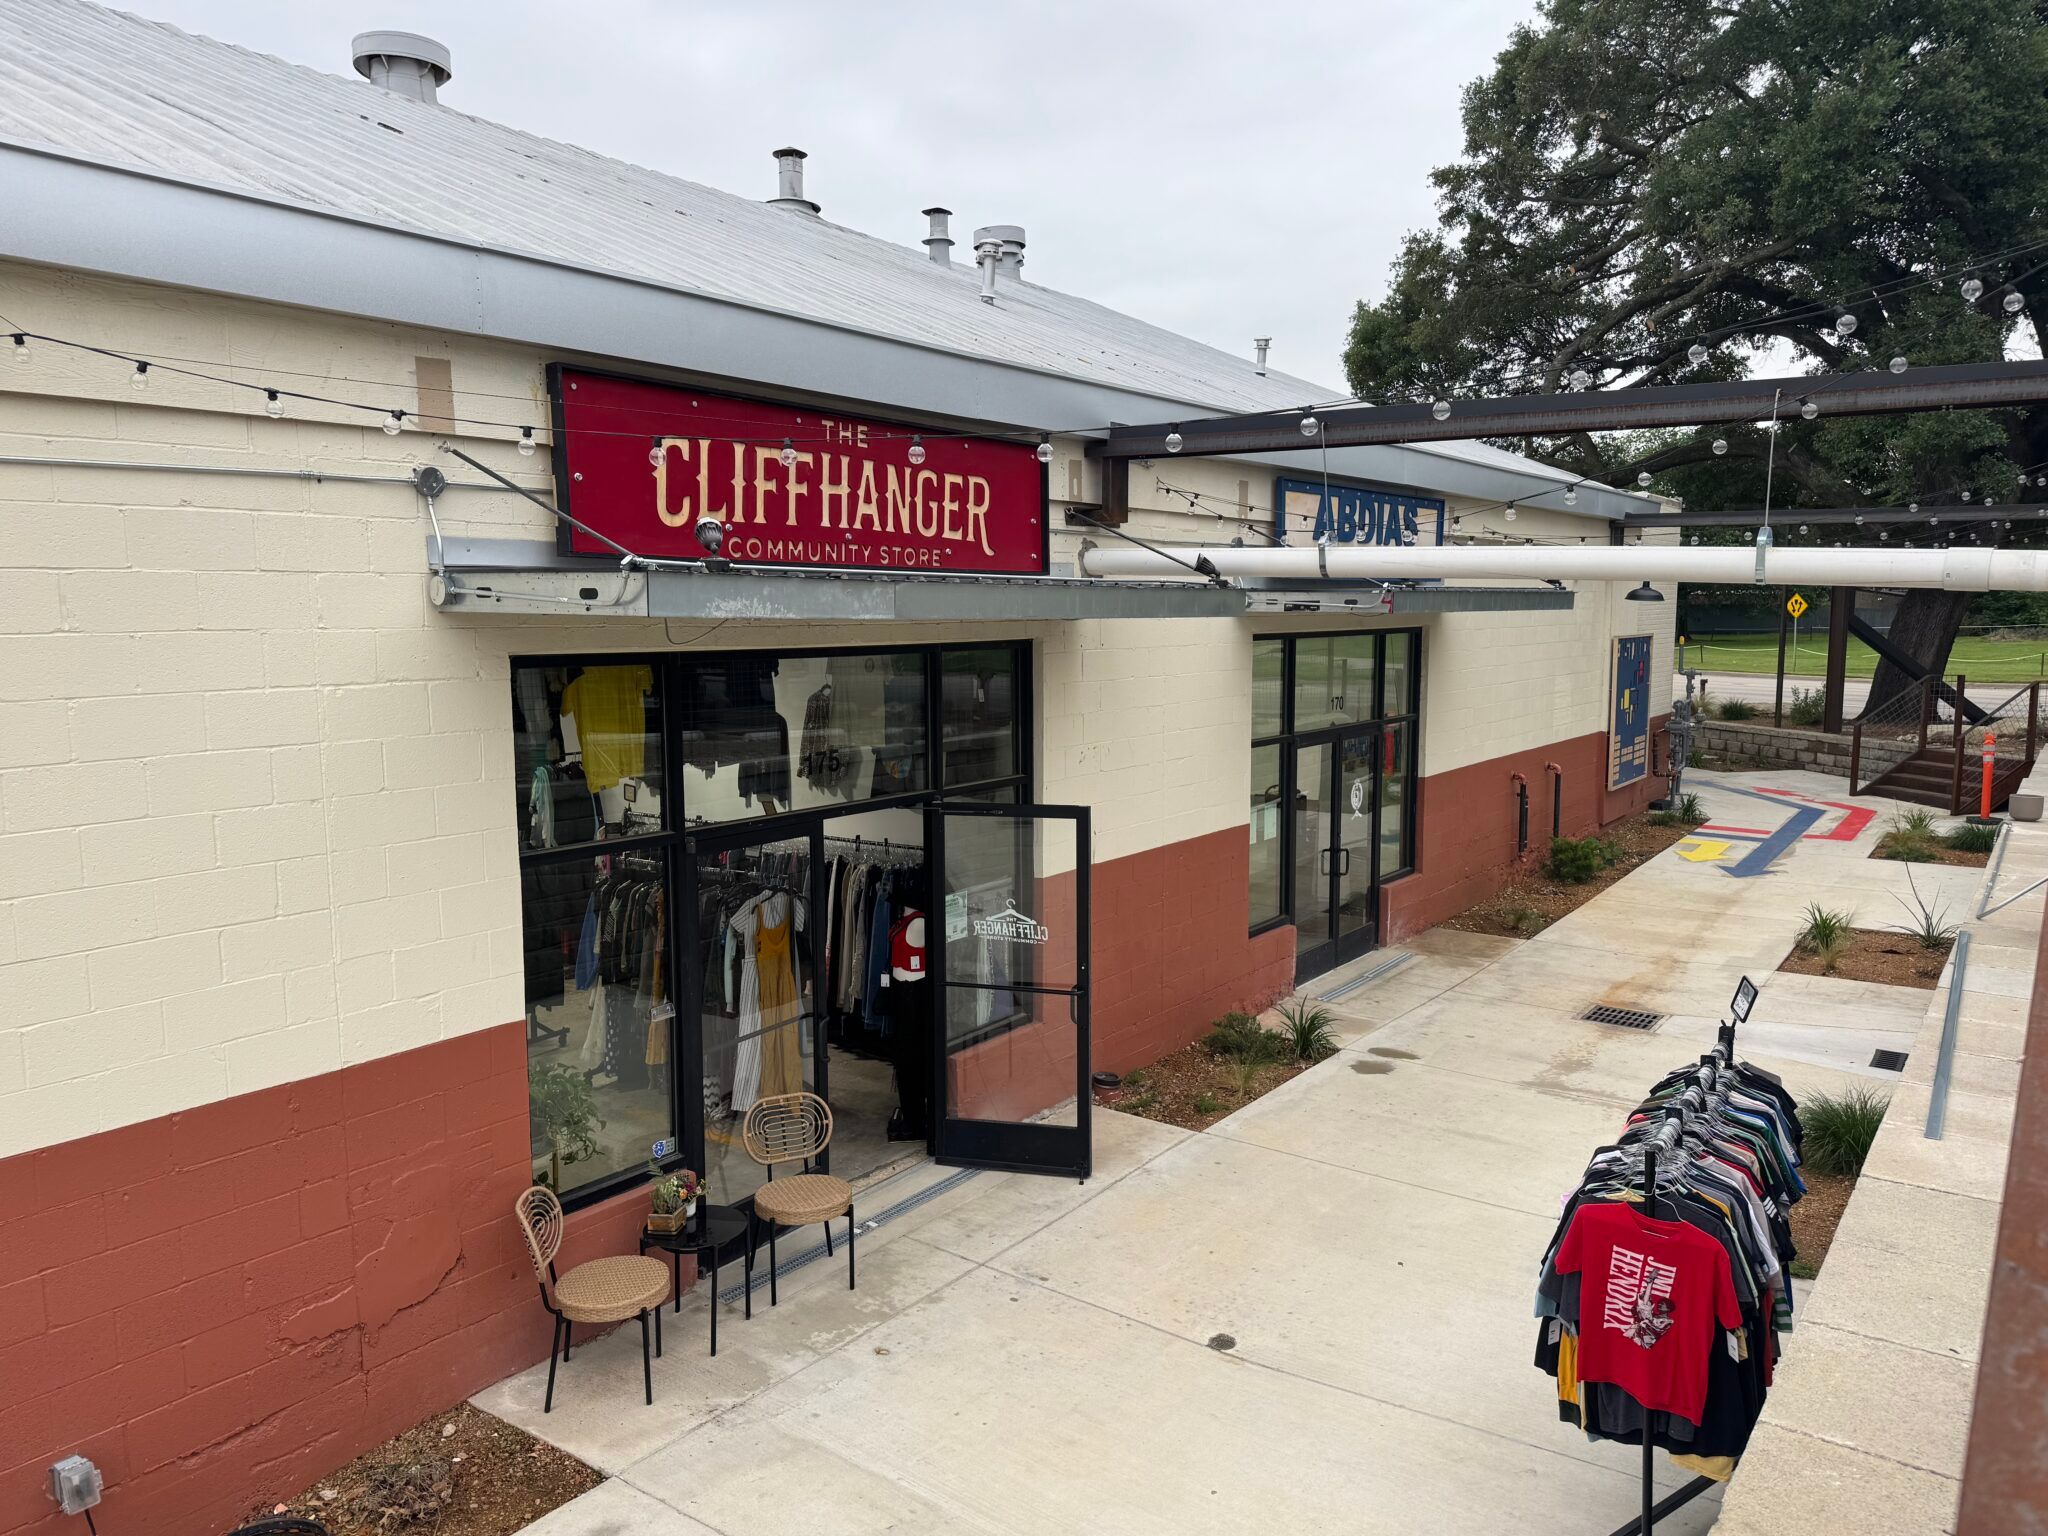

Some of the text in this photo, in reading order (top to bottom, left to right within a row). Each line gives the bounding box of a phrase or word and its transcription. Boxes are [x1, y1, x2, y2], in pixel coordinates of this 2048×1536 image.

[821, 419, 869, 449] THE
[652, 437, 996, 557] CLIFFHANGER
[1313, 491, 1419, 547] ABDIAS
[728, 538, 942, 567] COMMUNITY STORE
[1330, 695, 1345, 711] 170
[803, 749, 840, 775] 175
